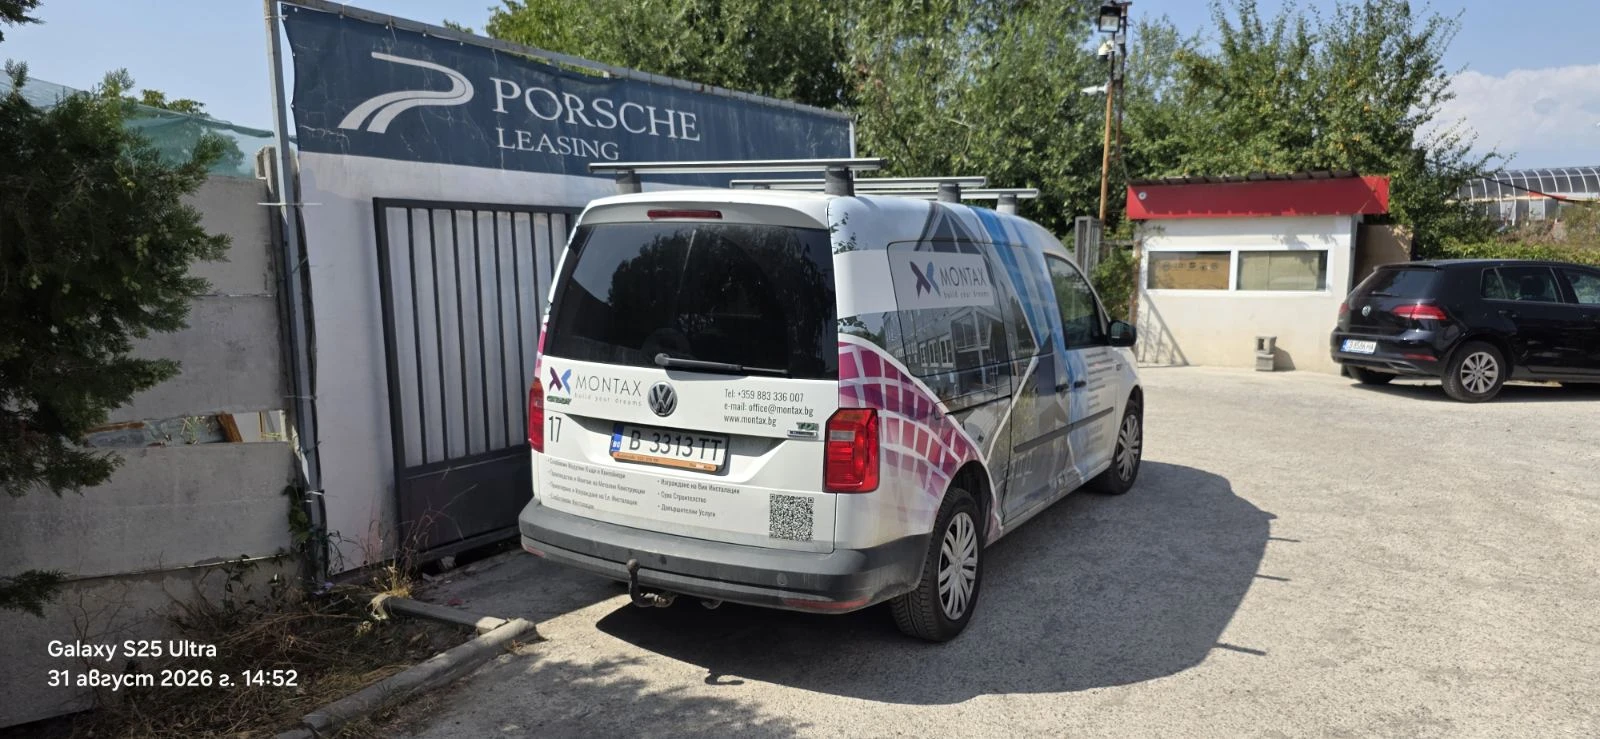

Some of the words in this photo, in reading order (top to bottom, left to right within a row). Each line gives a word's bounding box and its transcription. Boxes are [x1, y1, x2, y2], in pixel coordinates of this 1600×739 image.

[490, 77, 700, 142] PORSCHE
[496, 127, 619, 160] LEASING
[940, 266, 987, 286] MONTAX
[575, 375, 641, 396] MONTAX
[725, 389, 735, 398] Tel:
[738, 390, 754, 399] +359
[757, 391, 771, 400] 883
[773, 392, 787, 401] 336
[790, 393, 804, 402] 007
[724, 402, 746, 411] e-mail:
[748, 403, 813, 417] office@montax.bg
[549, 416, 562, 443] 17
[724, 415, 777, 427] www.montax.bg
[629, 430, 641, 450] B
[650, 432, 693, 457] 3313
[699, 438, 722, 461] TT
